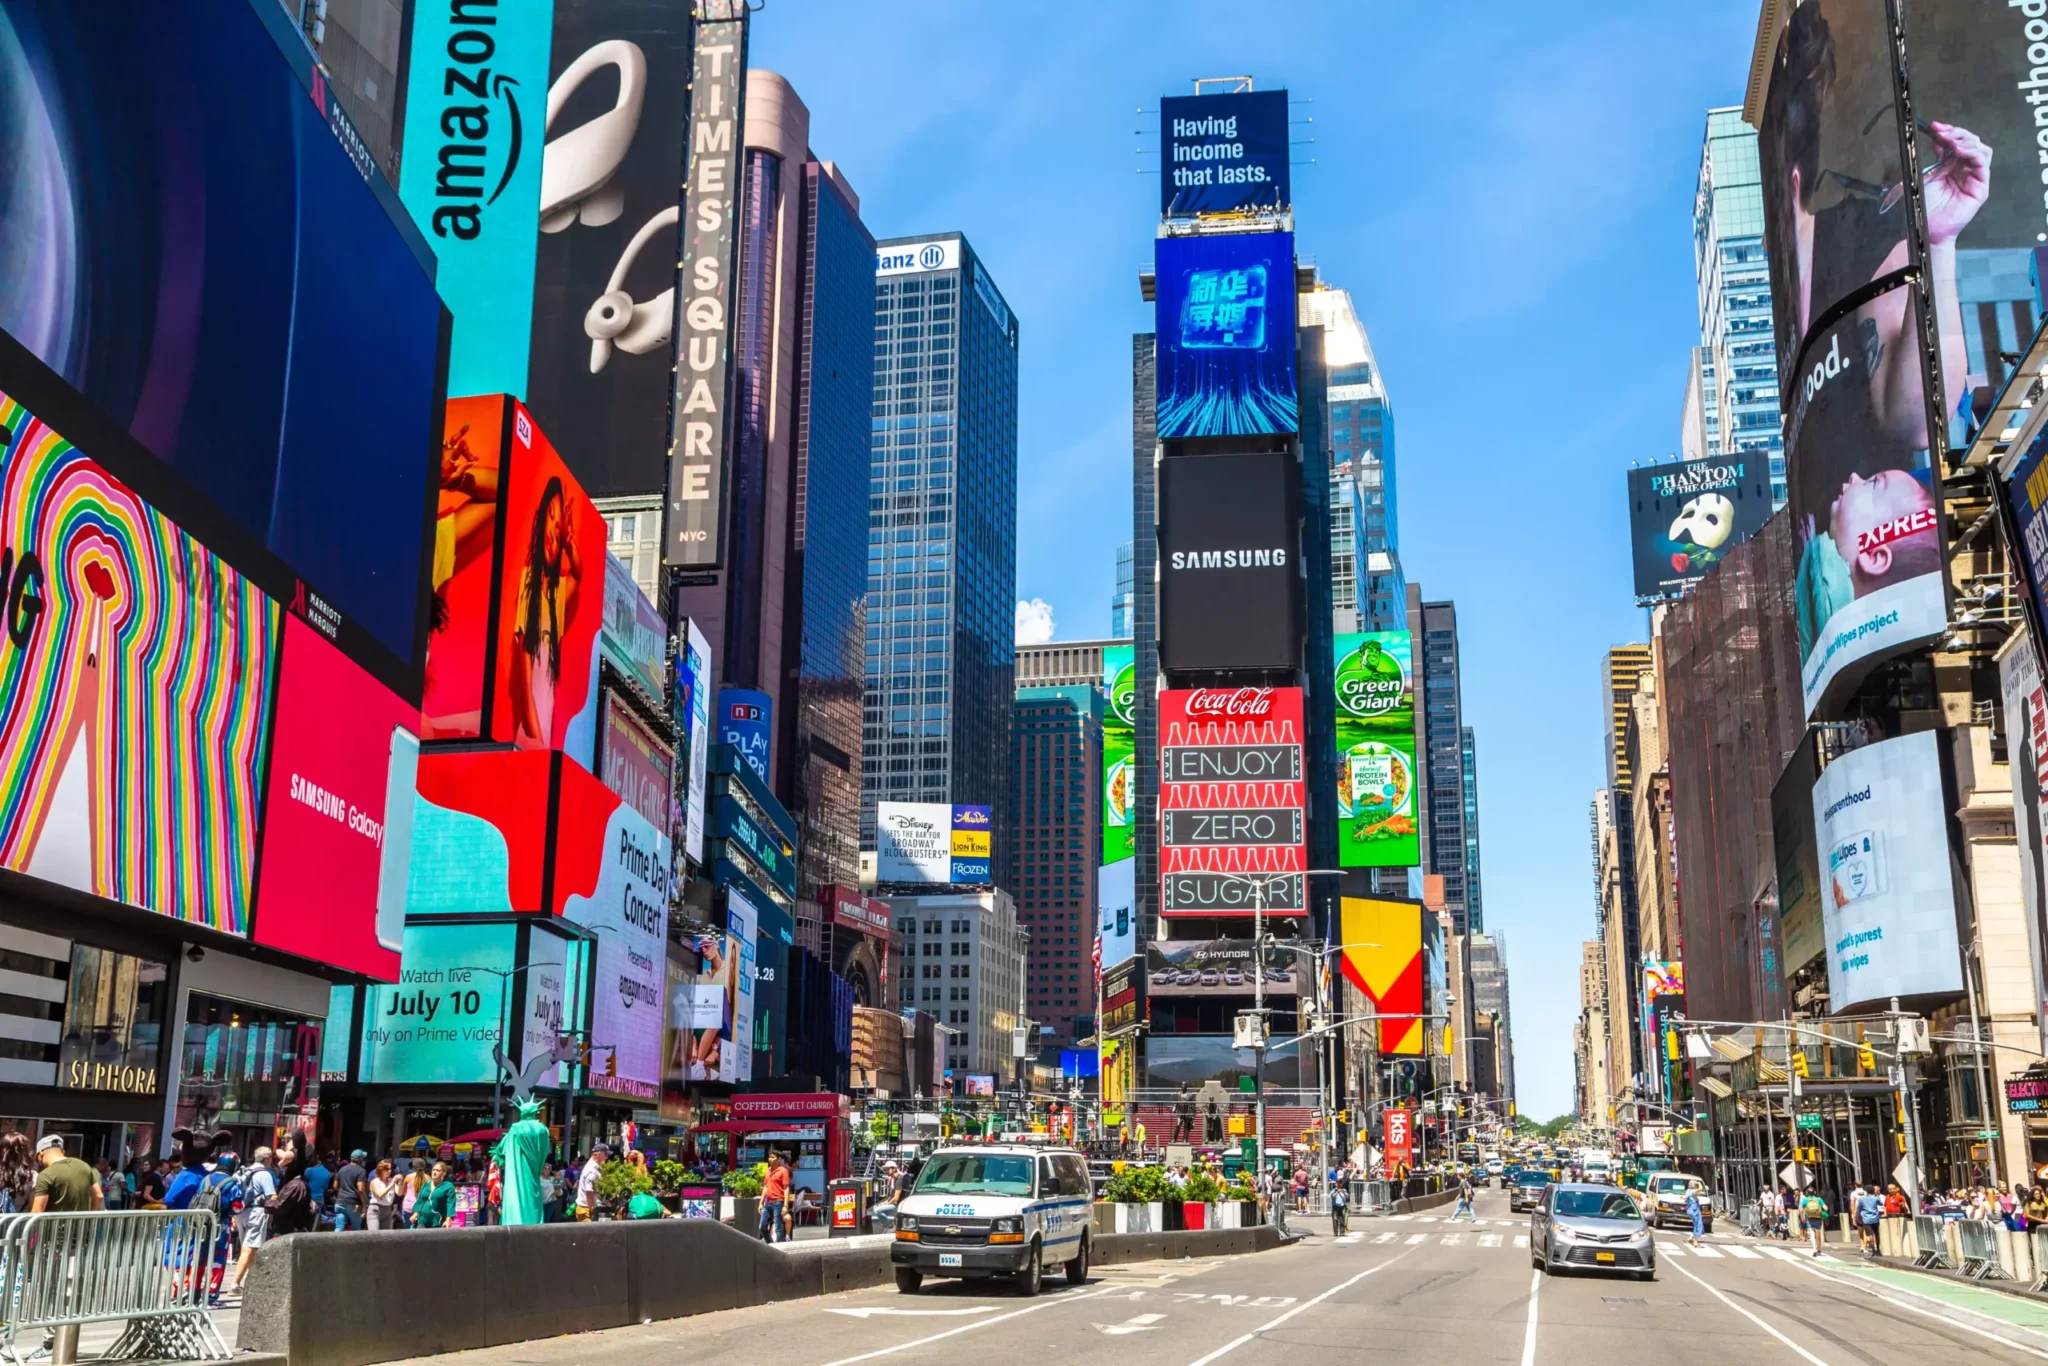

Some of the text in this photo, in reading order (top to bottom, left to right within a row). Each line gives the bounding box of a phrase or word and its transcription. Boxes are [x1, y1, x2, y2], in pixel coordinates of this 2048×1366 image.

[431, 0, 500, 241] amazon
[1173, 115, 1238, 139] Having
[332, 102, 376, 176] MARRIOTT
[695, 44, 735, 233] TIMES
[1173, 142, 1244, 162] income
[1173, 164, 1272, 186] that lasts.
[682, 255, 725, 501] SQUARE
[518, 416, 531, 443] SZA
[1650, 463, 1745, 491] PHANTOM
[1685, 461, 1709, 472] THE
[1660, 478, 1738, 497] OF THE OPERA
[679, 530, 708, 542] NYC
[1172, 548, 1286, 570] SAMSUNG
[310, 592, 342, 625] MARRIOTT
[308, 608, 337, 638] MARQUIS
[1858, 609, 1899, 639] project
[1342, 678, 1401, 695] Green
[1185, 686, 1275, 716] Coca-Cola
[1350, 693, 1403, 711] Giant
[735, 706, 766, 721] npr
[1181, 751, 1283, 775] ENJOY
[1354, 772, 1388, 780] PROTEIN
[290, 772, 384, 849] SAMSUNG Galaxy
[953, 811, 989, 824] Aladdin
[886, 830, 941, 840] SETS THE BAR FOR
[1191, 815, 1276, 840] ZERO
[891, 838, 936, 849] BROADWAY
[619, 827, 669, 905] Prime Day
[952, 862, 988, 876] FROZEN
[1177, 879, 1289, 904] SUGAR
[623, 882, 661, 939] Concert
[1855, 926, 1882, 949] purest
[1210, 951, 1250, 959] HYUNDAI
[1850, 951, 1870, 971] wipes
[401, 968, 472, 983] Watch live
[619, 975, 657, 1008] amazon music
[387, 989, 481, 1022] July 10
[534, 994, 550, 1026] July
[366, 1026, 391, 1046] only
[394, 1030, 412, 1041] on
[417, 1026, 458, 1041] Prime
[69, 1060, 156, 1094] SEPHORA
[734, 1101, 780, 1111] COFFEED
[784, 1101, 805, 1110] SWEET
[806, 1100, 835, 1110] CHURROS
[2010, 1099, 2039, 1110] CAMERA
[1391, 1112, 1408, 1145] tkts
[935, 1207, 976, 1216] POLICE
[14, 1263, 25, 1305] NYPD
